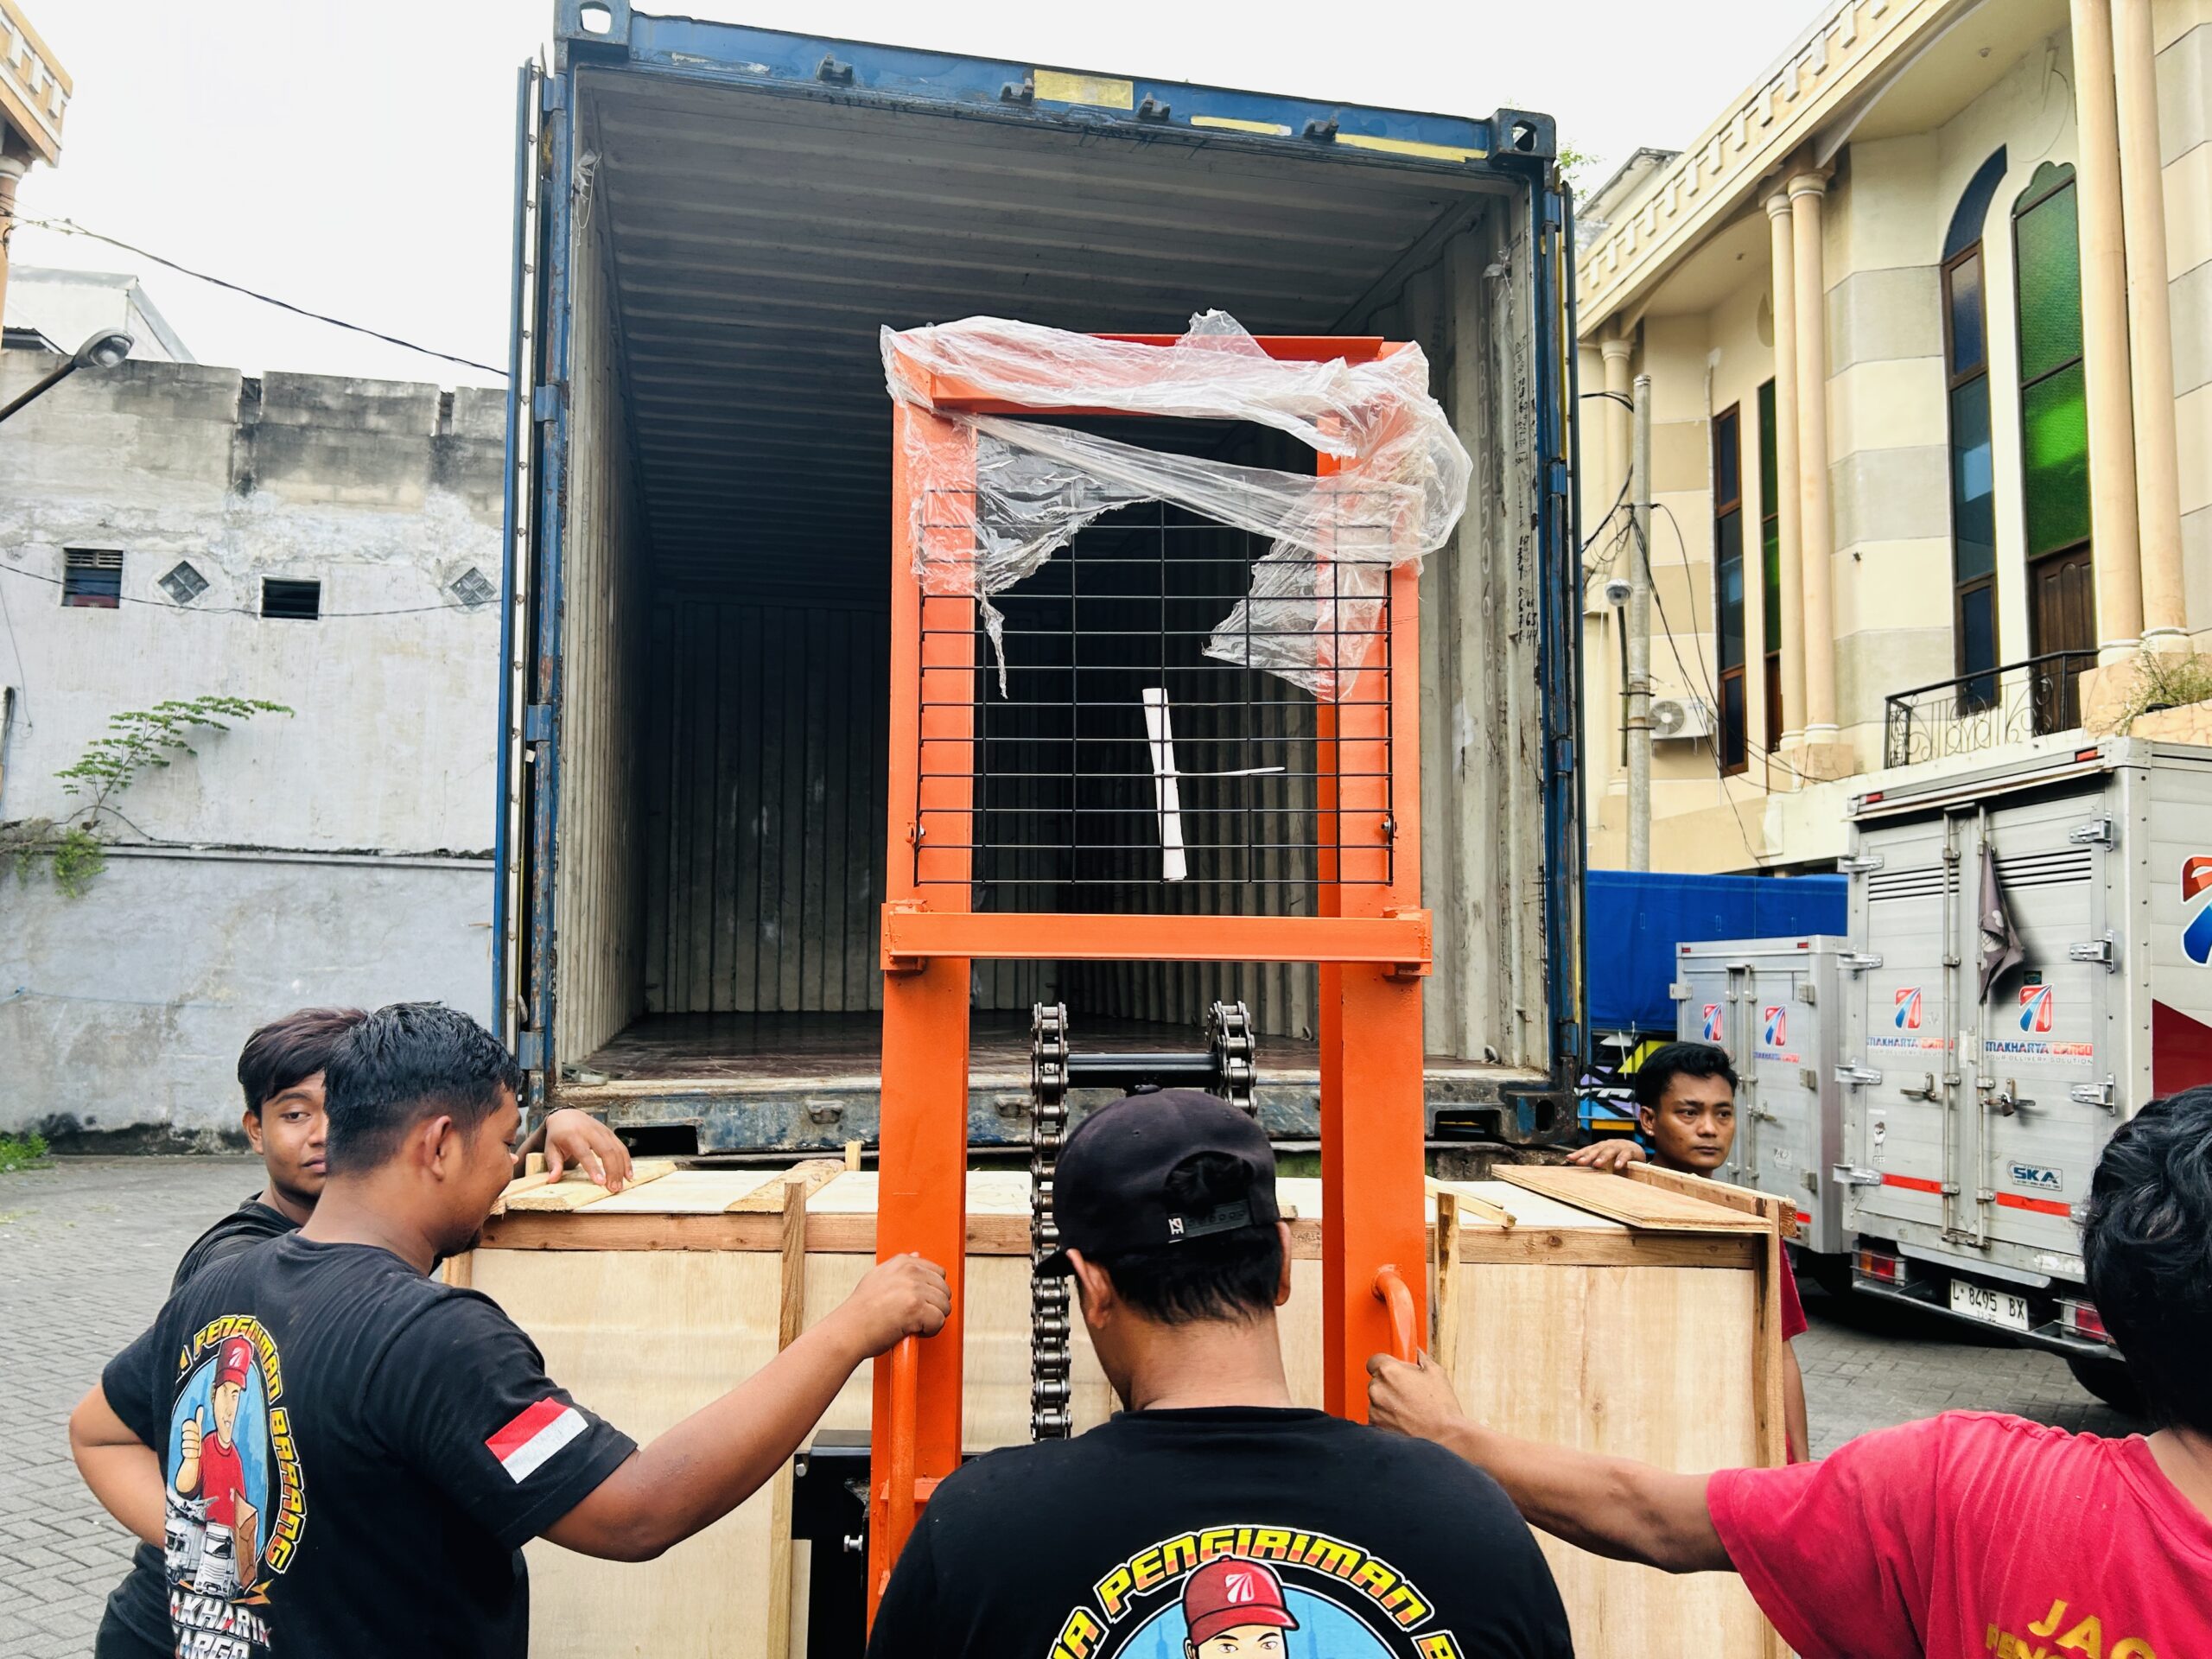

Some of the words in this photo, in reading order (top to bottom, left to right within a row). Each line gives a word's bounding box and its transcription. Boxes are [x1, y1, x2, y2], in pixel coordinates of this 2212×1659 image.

[1985, 1040, 2050, 1054] MAKHARYA
[2013, 1166, 2059, 1185] SKA
[1968, 1287, 1998, 1312] 8495
[2008, 1297, 2025, 1320] BX
[266, 1408, 307, 1573] BARANG
[1094, 1525, 1434, 1631] PENGIRIMAN
